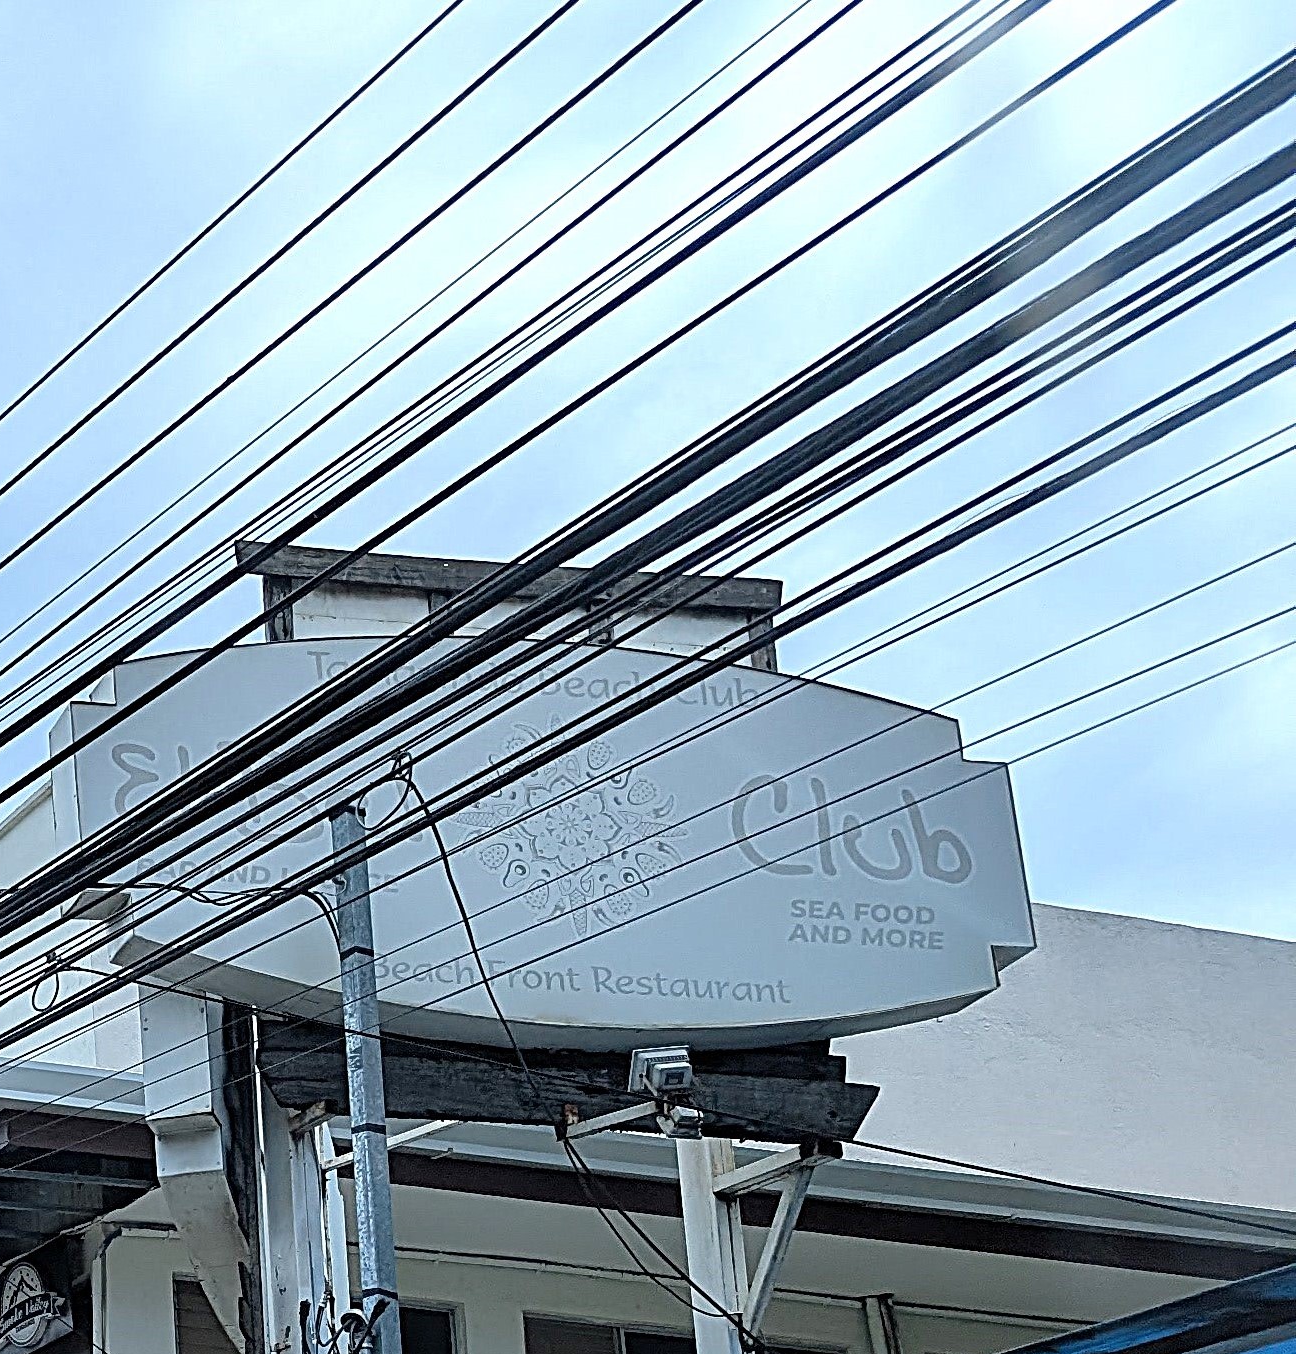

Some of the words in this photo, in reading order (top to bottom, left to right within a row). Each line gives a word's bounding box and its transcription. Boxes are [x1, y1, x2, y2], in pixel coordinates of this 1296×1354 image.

[731, 774, 973, 884] Club
[790, 899, 845, 921] SEA
[853, 902, 936, 925] FOOD
[788, 924, 852, 945] AND
[860, 927, 944, 950] MORE
[374, 952, 475, 985] Beach
[488, 959, 581, 993] Front
[591, 965, 792, 1004] Restaurant
